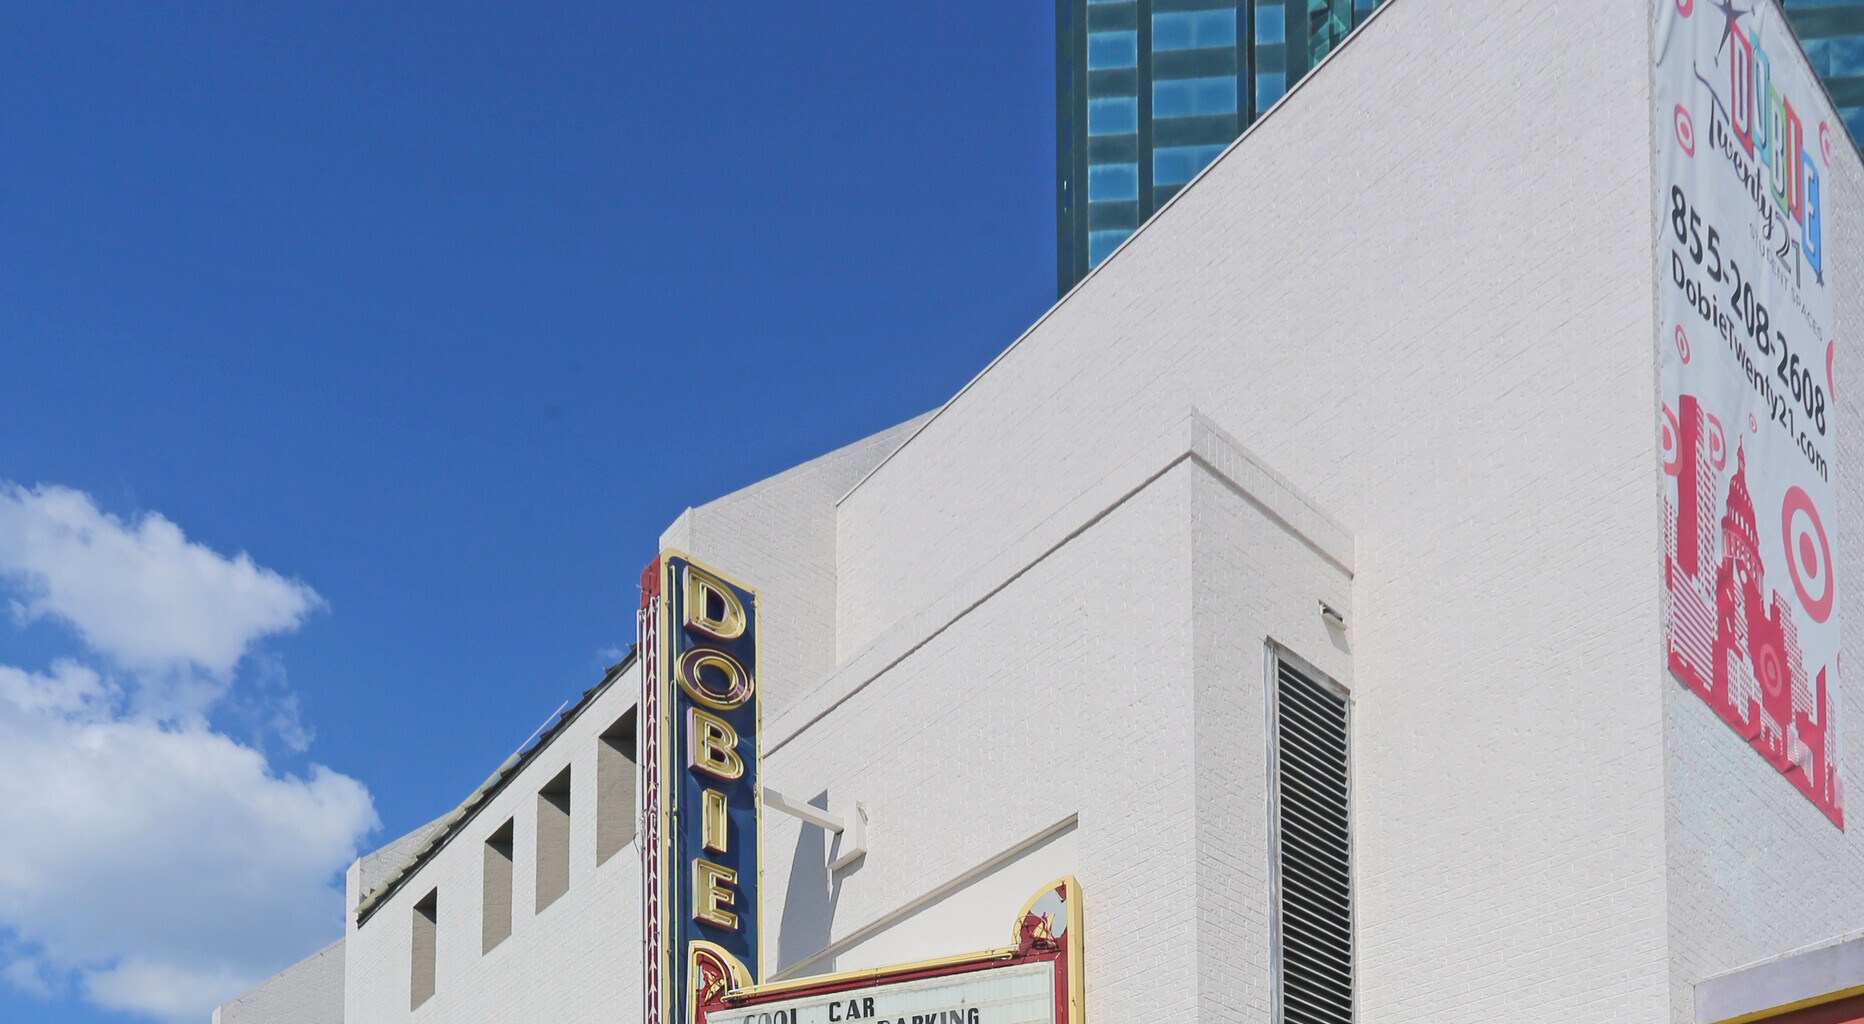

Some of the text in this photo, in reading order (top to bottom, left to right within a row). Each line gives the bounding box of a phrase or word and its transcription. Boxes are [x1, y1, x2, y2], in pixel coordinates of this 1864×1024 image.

[1729, 15, 1820, 278] DOBIE
[1671, 184, 1826, 437] 855-208-2608
[1672, 249, 1828, 482] DobieTwenty21.com
[1750, 222, 1823, 342] STUDENT SPACES
[675, 564, 755, 932] DOBIE
[828, 997, 875, 1022] CAR
